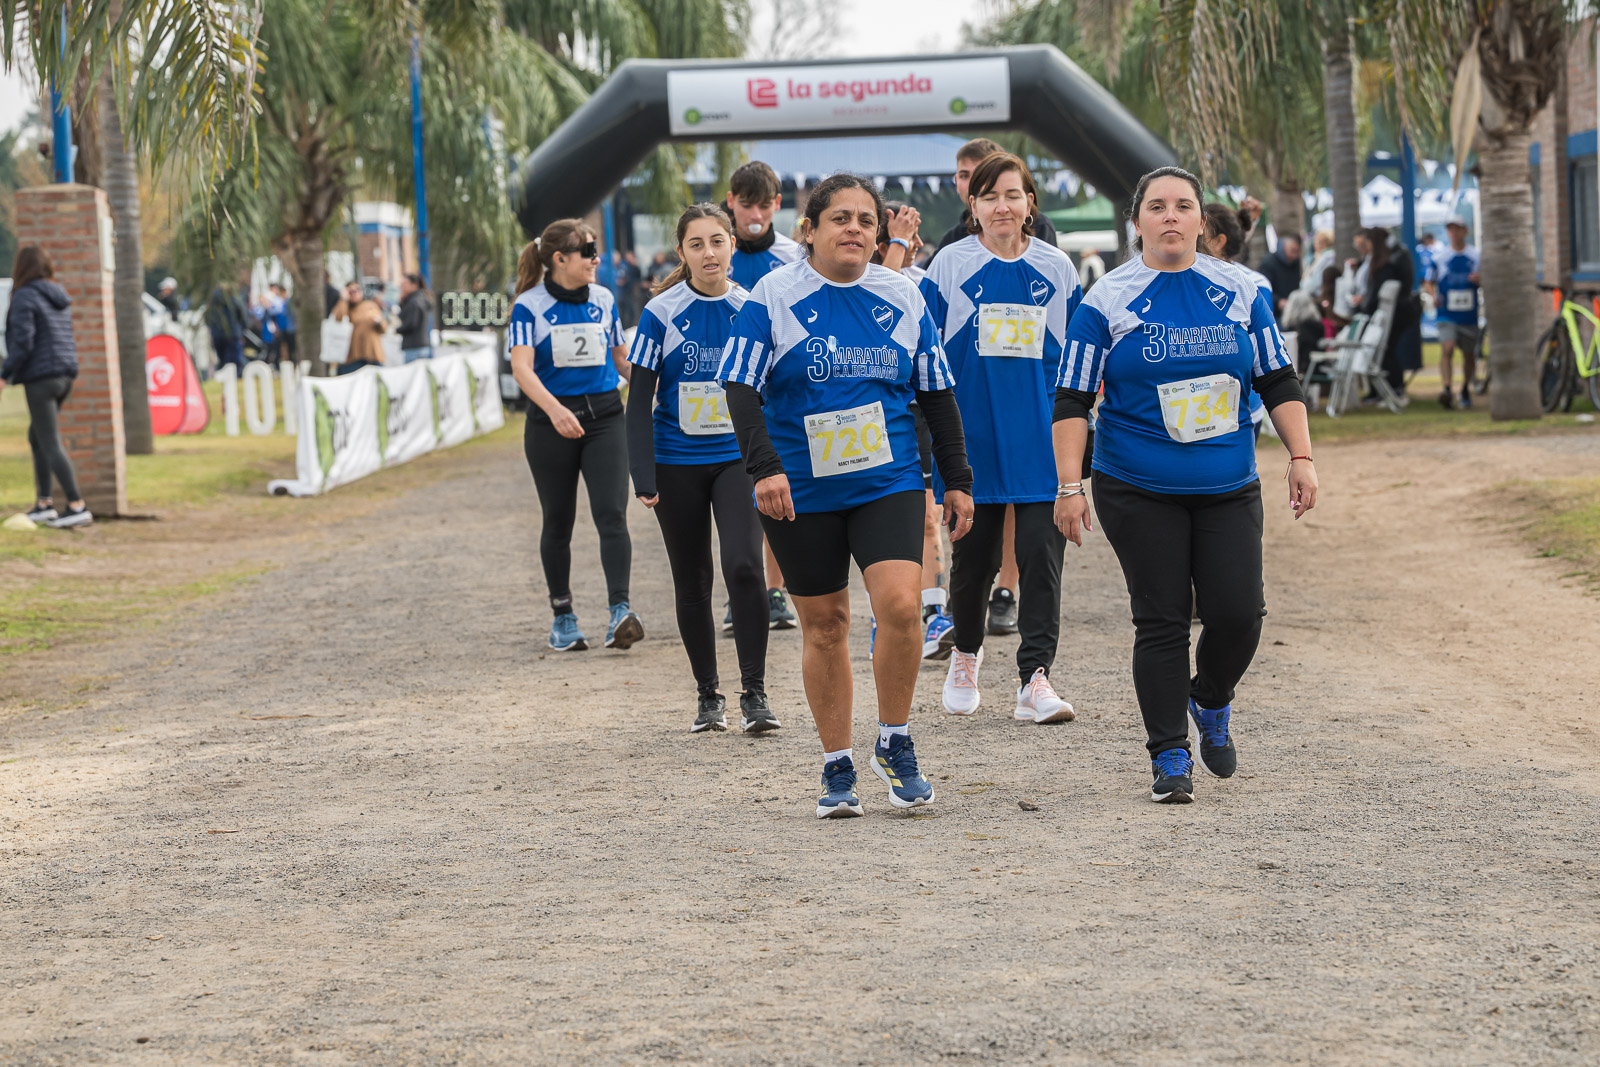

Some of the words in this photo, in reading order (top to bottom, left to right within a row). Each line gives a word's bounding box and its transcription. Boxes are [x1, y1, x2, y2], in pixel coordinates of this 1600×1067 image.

[788, 78, 811, 99] la
[819, 73, 932, 101] segunda
[574, 336, 589, 356] 2
[986, 318, 1036, 346] 735
[1143, 322, 1166, 363] 3
[1167, 323, 1236, 345] MARATÓN
[682, 340, 699, 375] 3
[806, 336, 830, 383] 3
[833, 345, 899, 368] MARATÓN
[687, 396, 731, 423] 71
[835, 414, 842, 425] 3
[1168, 391, 1231, 430] 734
[816, 422, 882, 462] 720
